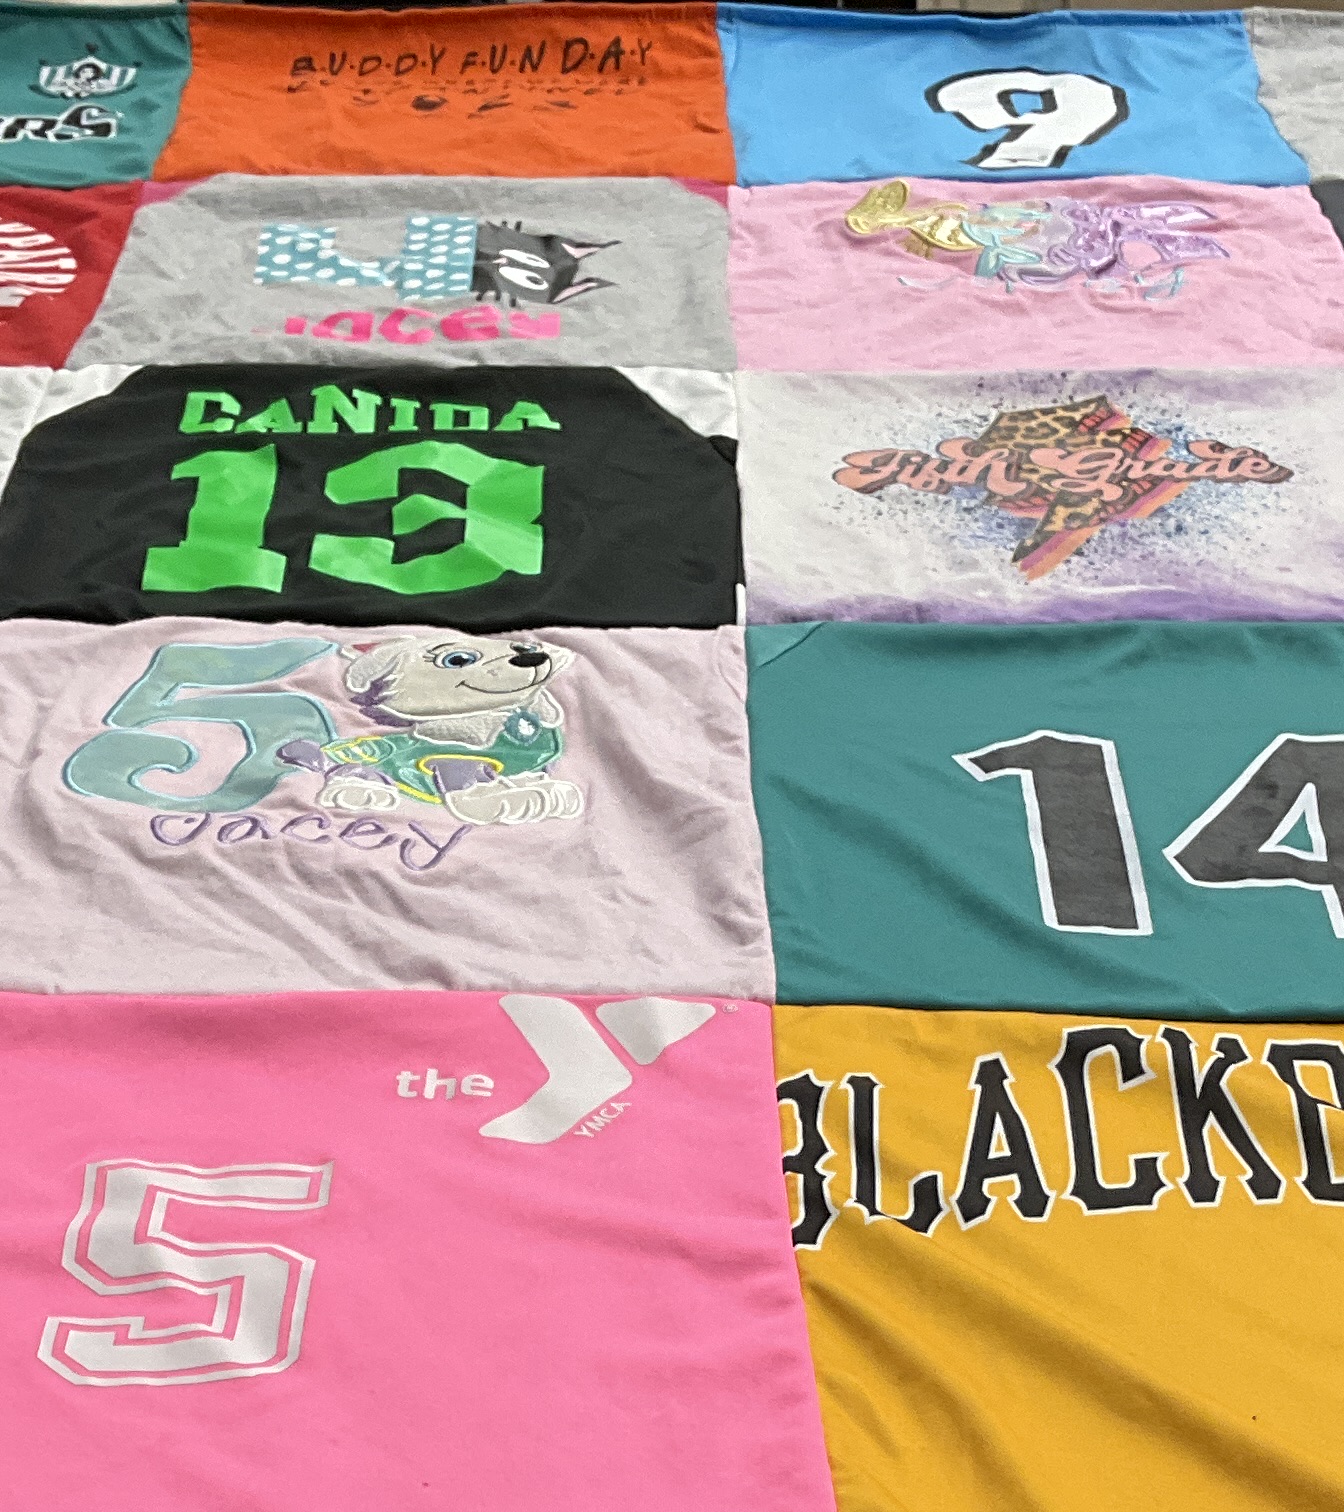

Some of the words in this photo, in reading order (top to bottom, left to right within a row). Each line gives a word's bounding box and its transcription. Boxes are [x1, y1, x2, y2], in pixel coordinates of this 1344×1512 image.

[924, 66, 1130, 170] 9
[250, 304, 562, 344] acey
[179, 385, 564, 434] CANIDA
[141, 441, 547, 595] 13
[61, 638, 340, 812] 5
[395, 1068, 495, 1100] the
[573, 1100, 632, 1139] YMCA
[36, 1159, 334, 1387] 5
